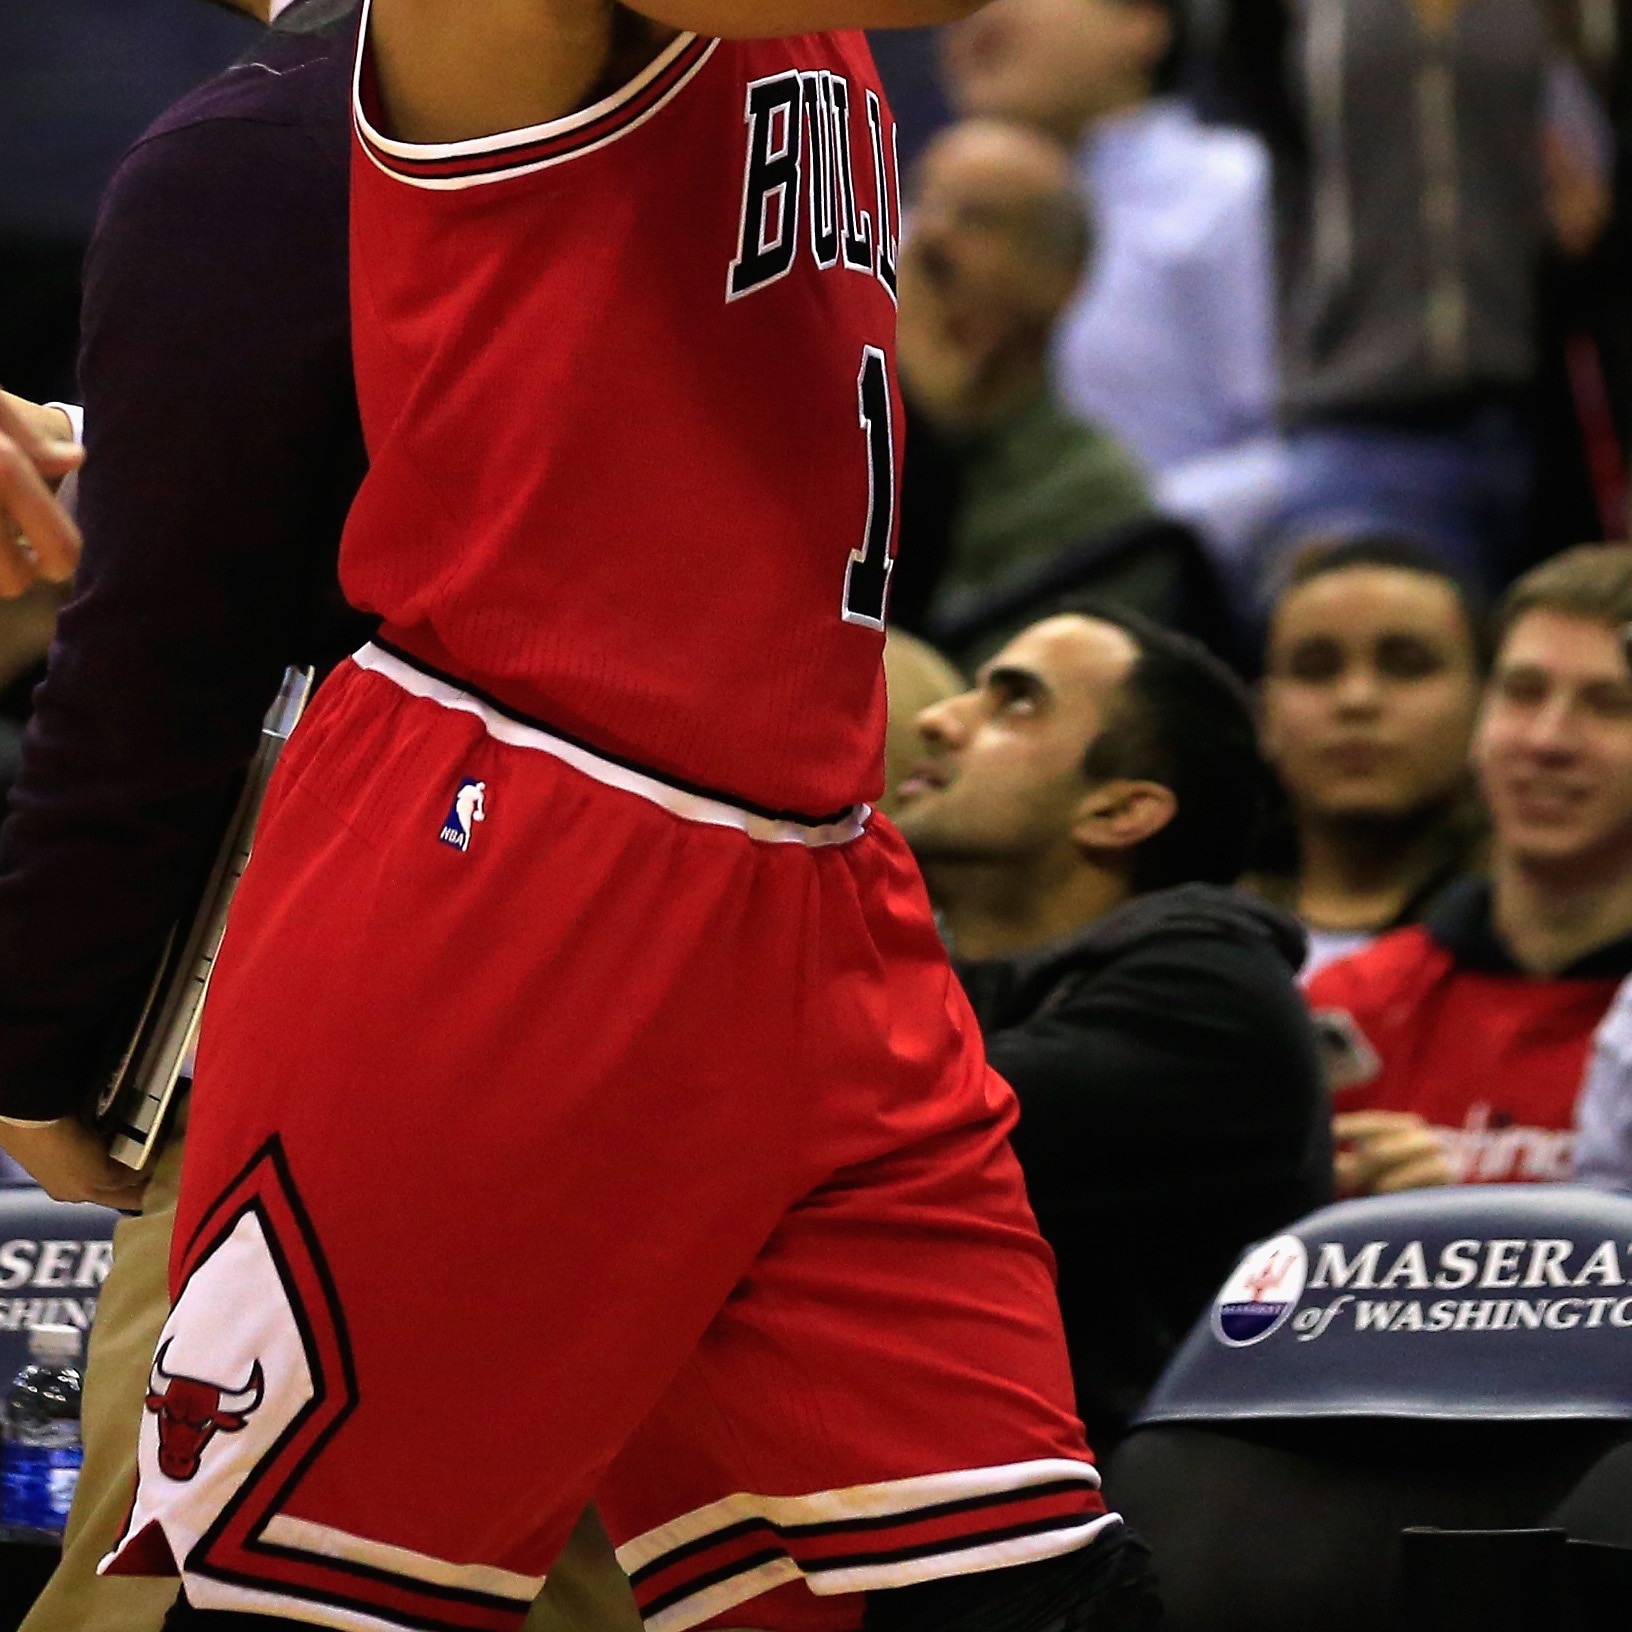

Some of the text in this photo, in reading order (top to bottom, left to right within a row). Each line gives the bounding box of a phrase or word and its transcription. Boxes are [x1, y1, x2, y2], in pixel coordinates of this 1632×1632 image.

[726, 69, 902, 306] BULL
[841, 344, 894, 631] 1
[439, 826, 465, 847] NBA
[1291, 1294, 1356, 1343] of
